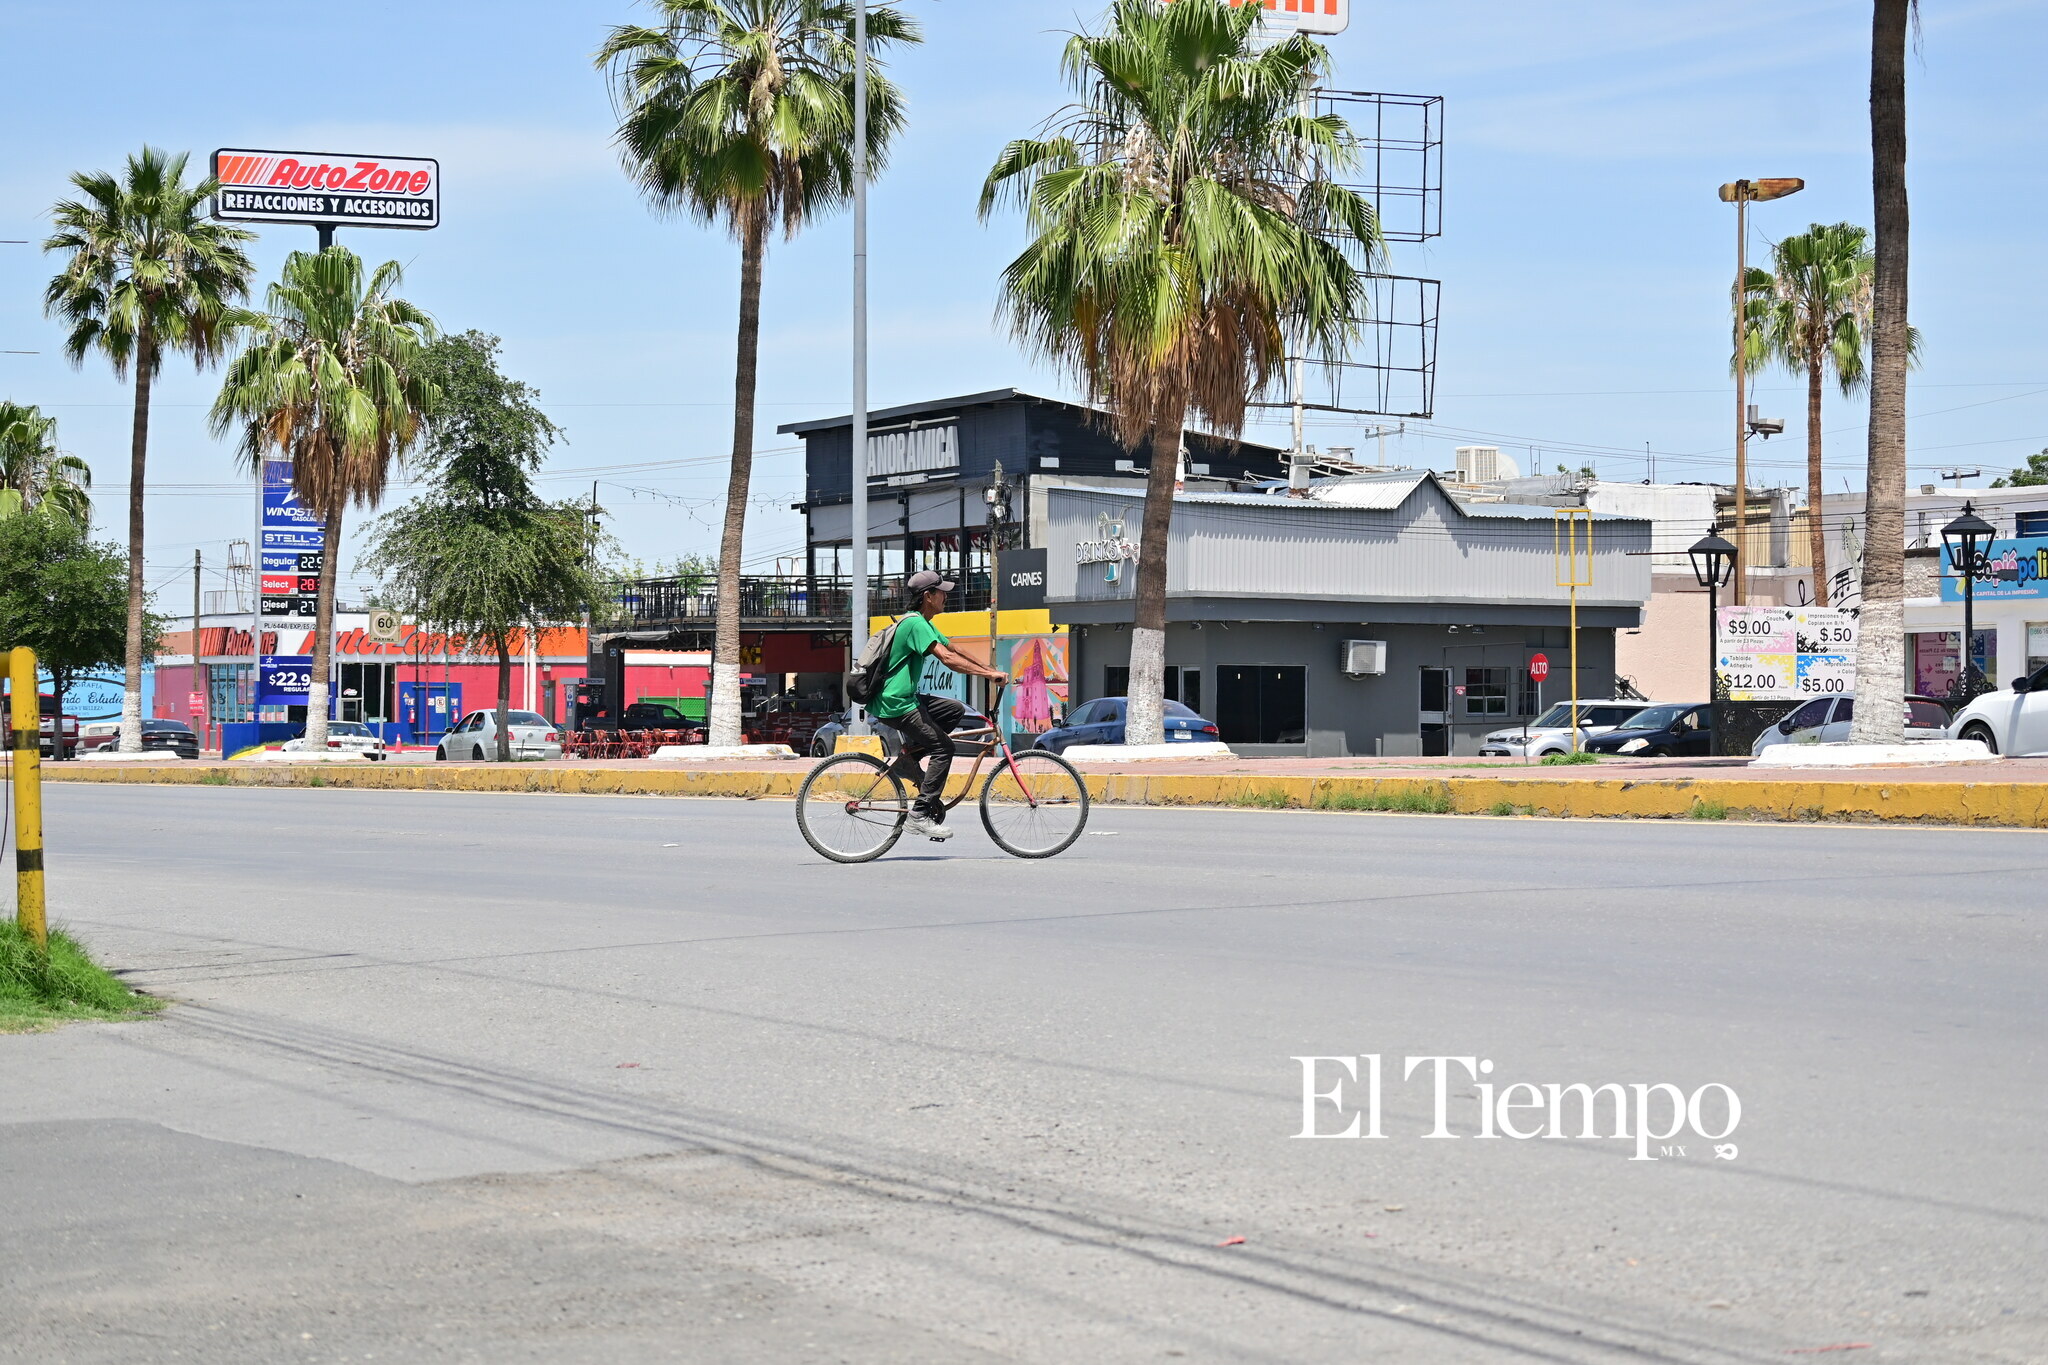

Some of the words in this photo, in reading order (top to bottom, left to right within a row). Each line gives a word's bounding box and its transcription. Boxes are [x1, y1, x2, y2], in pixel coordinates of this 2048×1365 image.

[269, 158, 430, 194] AutoZone
[225, 193, 324, 212] REFACCIONES
[330, 199, 339, 213] Y
[344, 199, 430, 217] ACCESORIOS
[867, 419, 960, 477] ANORÁMICA
[262, 556, 296, 567] Regular
[262, 580, 289, 588] Select
[1011, 571, 1042, 587] CARNES
[262, 600, 288, 609] Diesel
[301, 601, 317, 613] 27.
[264, 622, 316, 630] PL/6448/EXP/ES/2
[378, 617, 392, 629] 60
[1728, 619, 1771, 635] $9.00
[1820, 627, 1852, 643] $.50
[923, 660, 953, 690] Alan
[1530, 662, 1548, 674] ALTO
[1724, 673, 1776, 690] $12.00
[1802, 677, 1844, 693] $5.00
